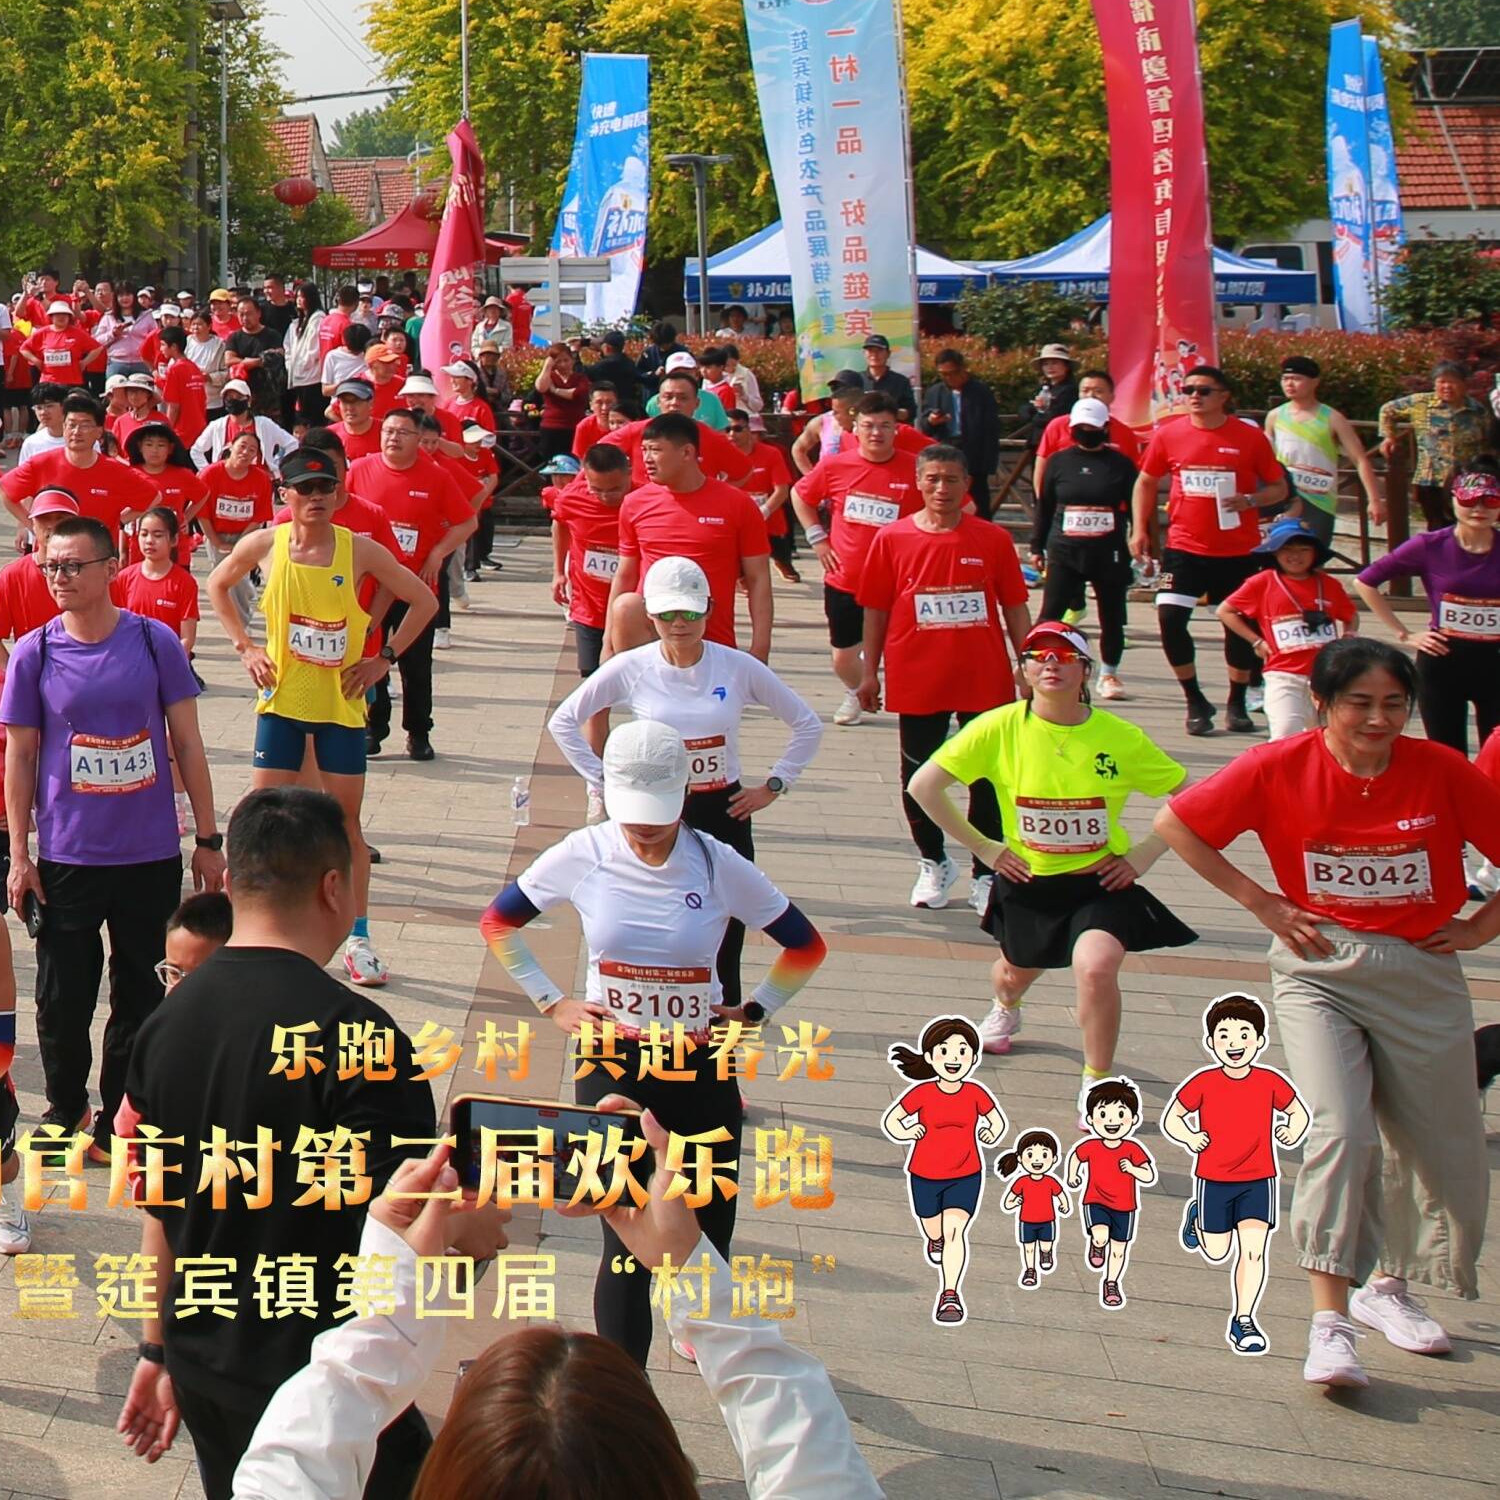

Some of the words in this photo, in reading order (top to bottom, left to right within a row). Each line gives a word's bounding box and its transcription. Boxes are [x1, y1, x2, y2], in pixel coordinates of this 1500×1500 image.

[218, 502, 252, 515] B2148
[846, 504, 894, 519] A1102
[919, 599, 981, 617] A1123
[291, 632, 348, 652] A1119
[75, 751, 148, 776] A1143
[1022, 815, 1101, 836] B2018
[1313, 860, 1420, 886] B2042
[606, 987, 702, 1020] B2103
